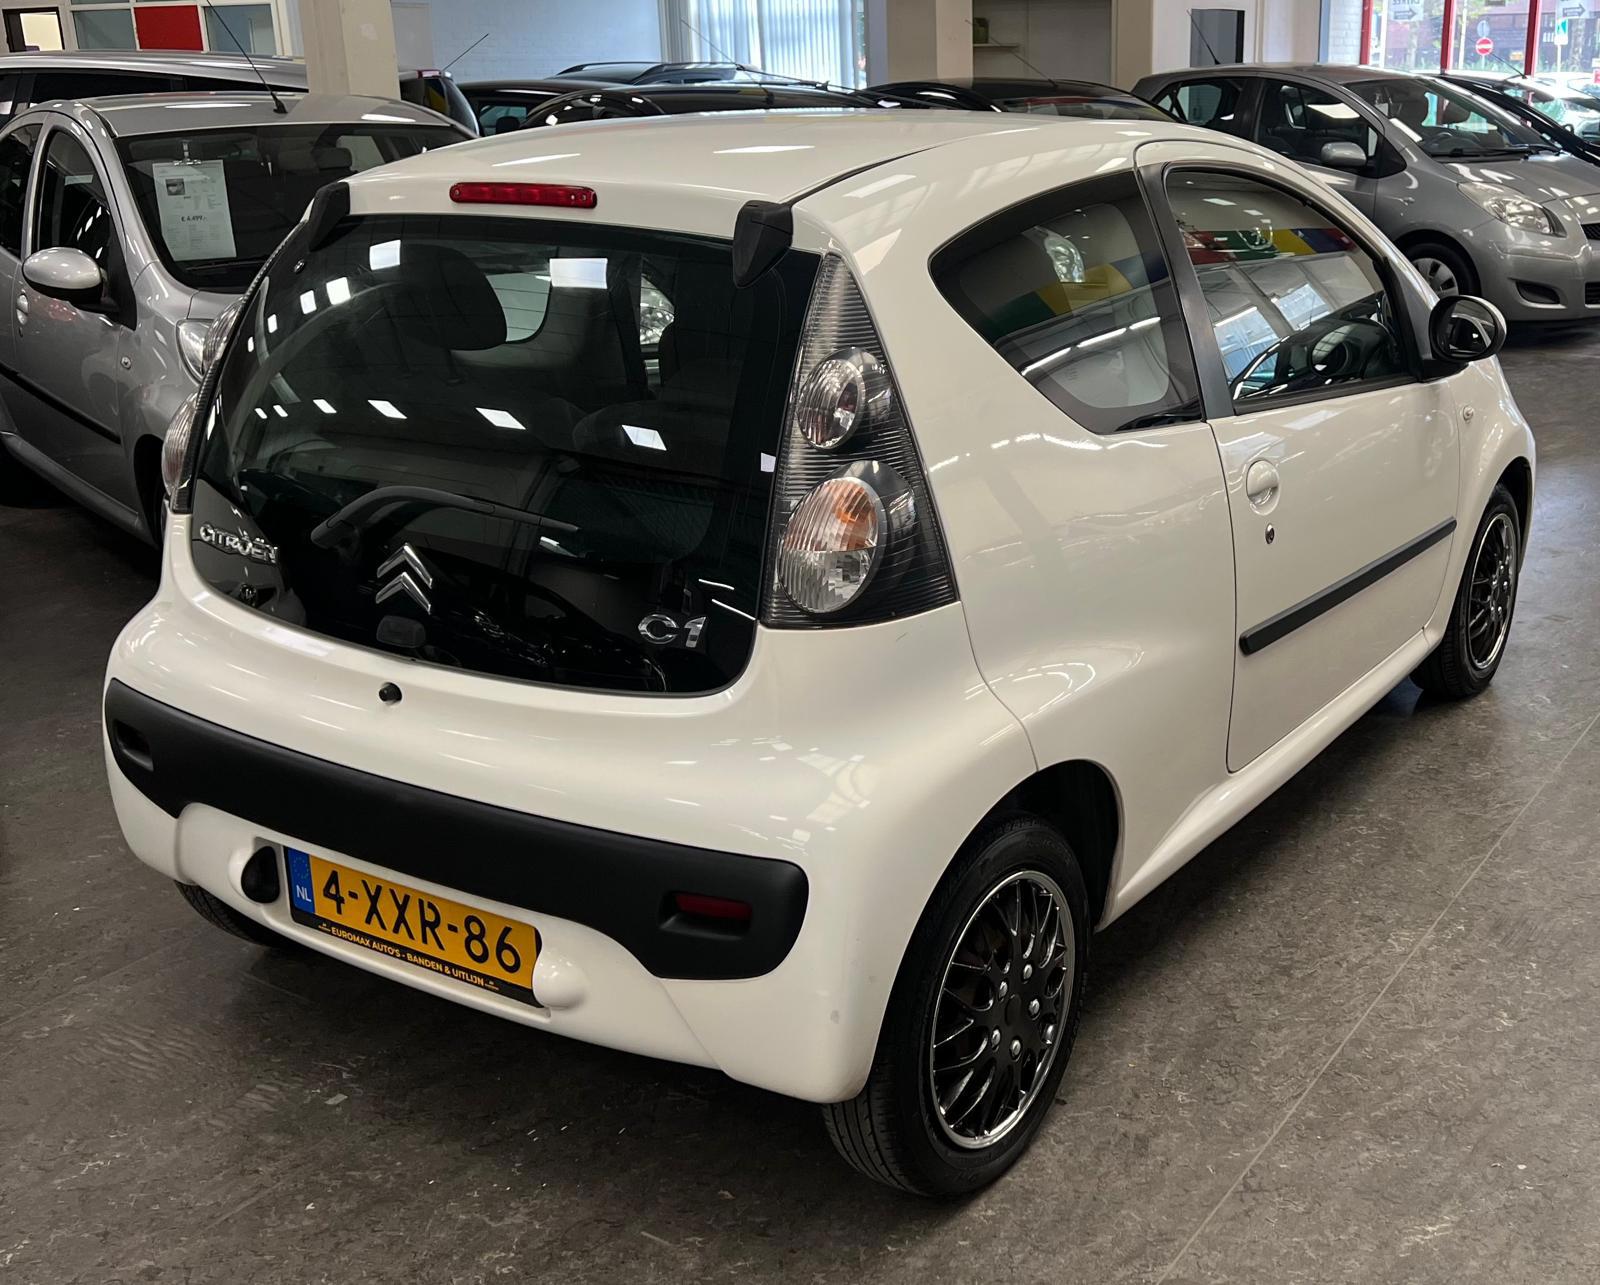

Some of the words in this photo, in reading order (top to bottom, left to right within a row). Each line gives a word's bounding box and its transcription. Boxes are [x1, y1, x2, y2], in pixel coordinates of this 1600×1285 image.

[200, 524, 278, 564] CITROËN
[638, 613, 707, 648] C1
[296, 884, 312, 903] NL
[323, 870, 521, 974] 4-XXR-86
[331, 926, 371, 948] EUROMAX
[372, 941, 401, 958] AUTO'S
[406, 953, 443, 972] BANDEN
[444, 966, 451, 975] &
[452, 968, 484, 986] UITLIJN
